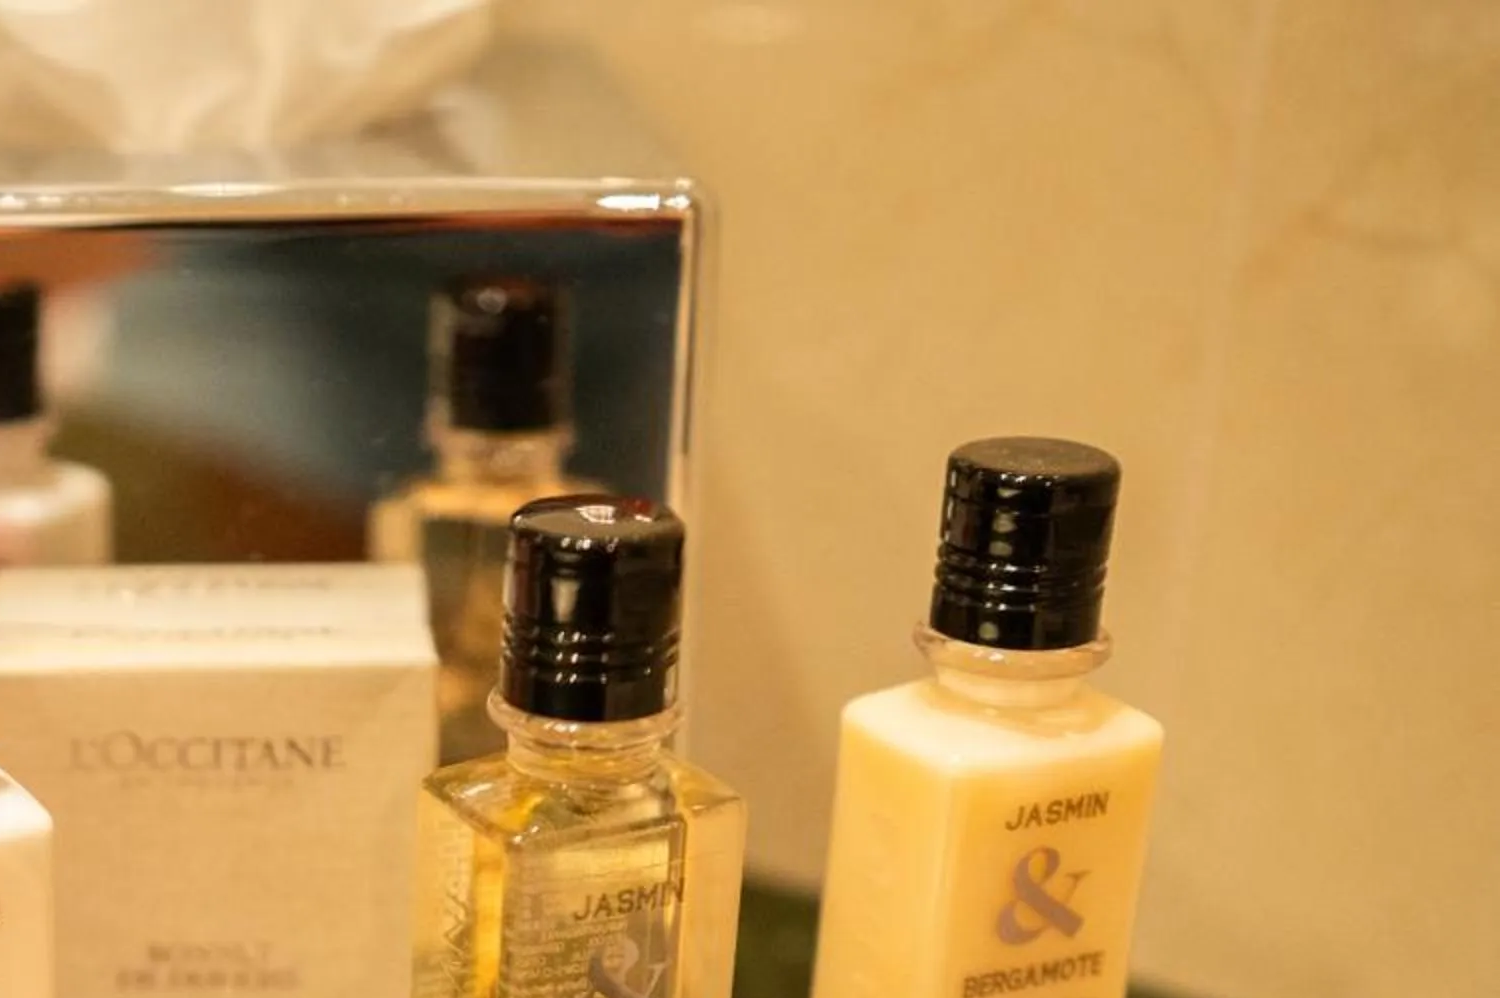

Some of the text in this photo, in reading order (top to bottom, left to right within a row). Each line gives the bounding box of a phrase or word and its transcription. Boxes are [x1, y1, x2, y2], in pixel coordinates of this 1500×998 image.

[69, 730, 347, 772] L'OCCITANE
[1005, 791, 1110, 831] JASMIN
[574, 877, 684, 922] JASMIN
[996, 846, 1091, 946] &
